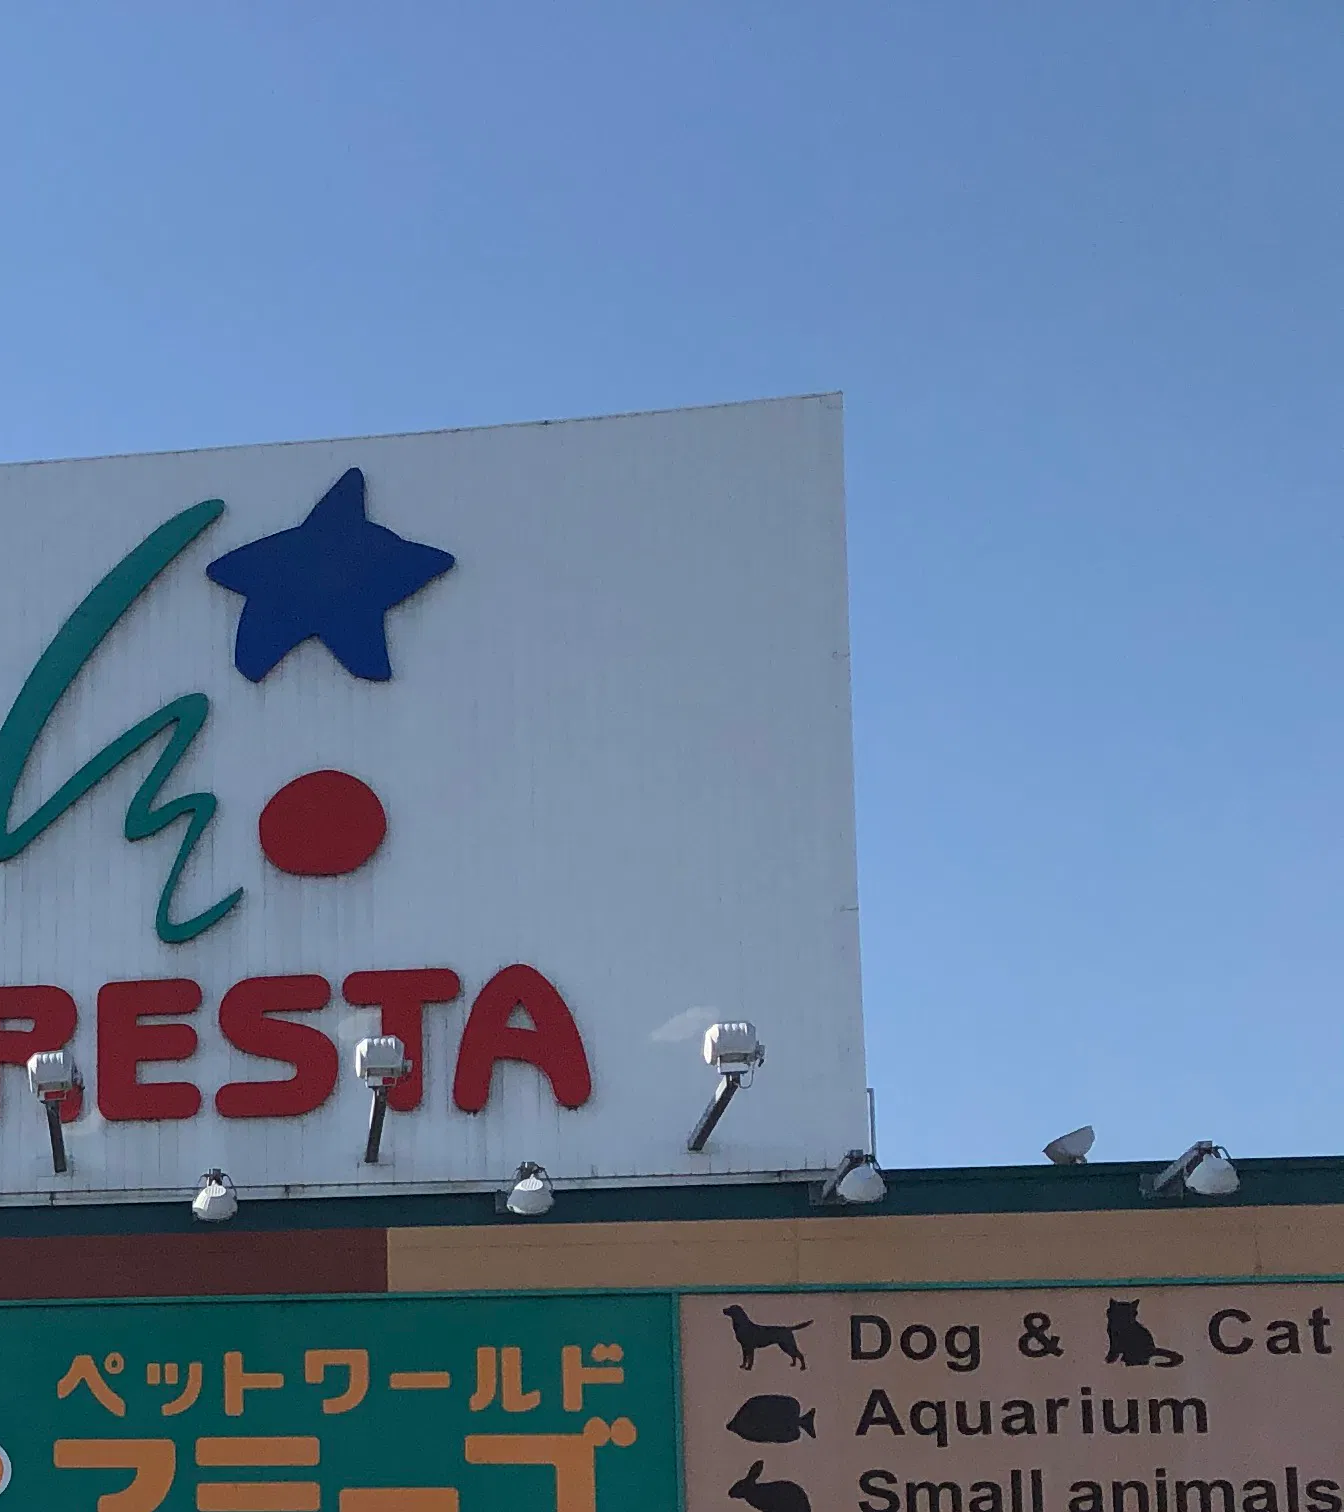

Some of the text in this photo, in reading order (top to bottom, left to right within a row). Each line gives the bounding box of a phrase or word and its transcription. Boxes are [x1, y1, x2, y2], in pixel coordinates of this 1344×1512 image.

[849, 1306, 1333, 1373] Dog & Cat
[56, 1343, 625, 1418] ペットワールド
[854, 1386, 1210, 1448] Aquarium
